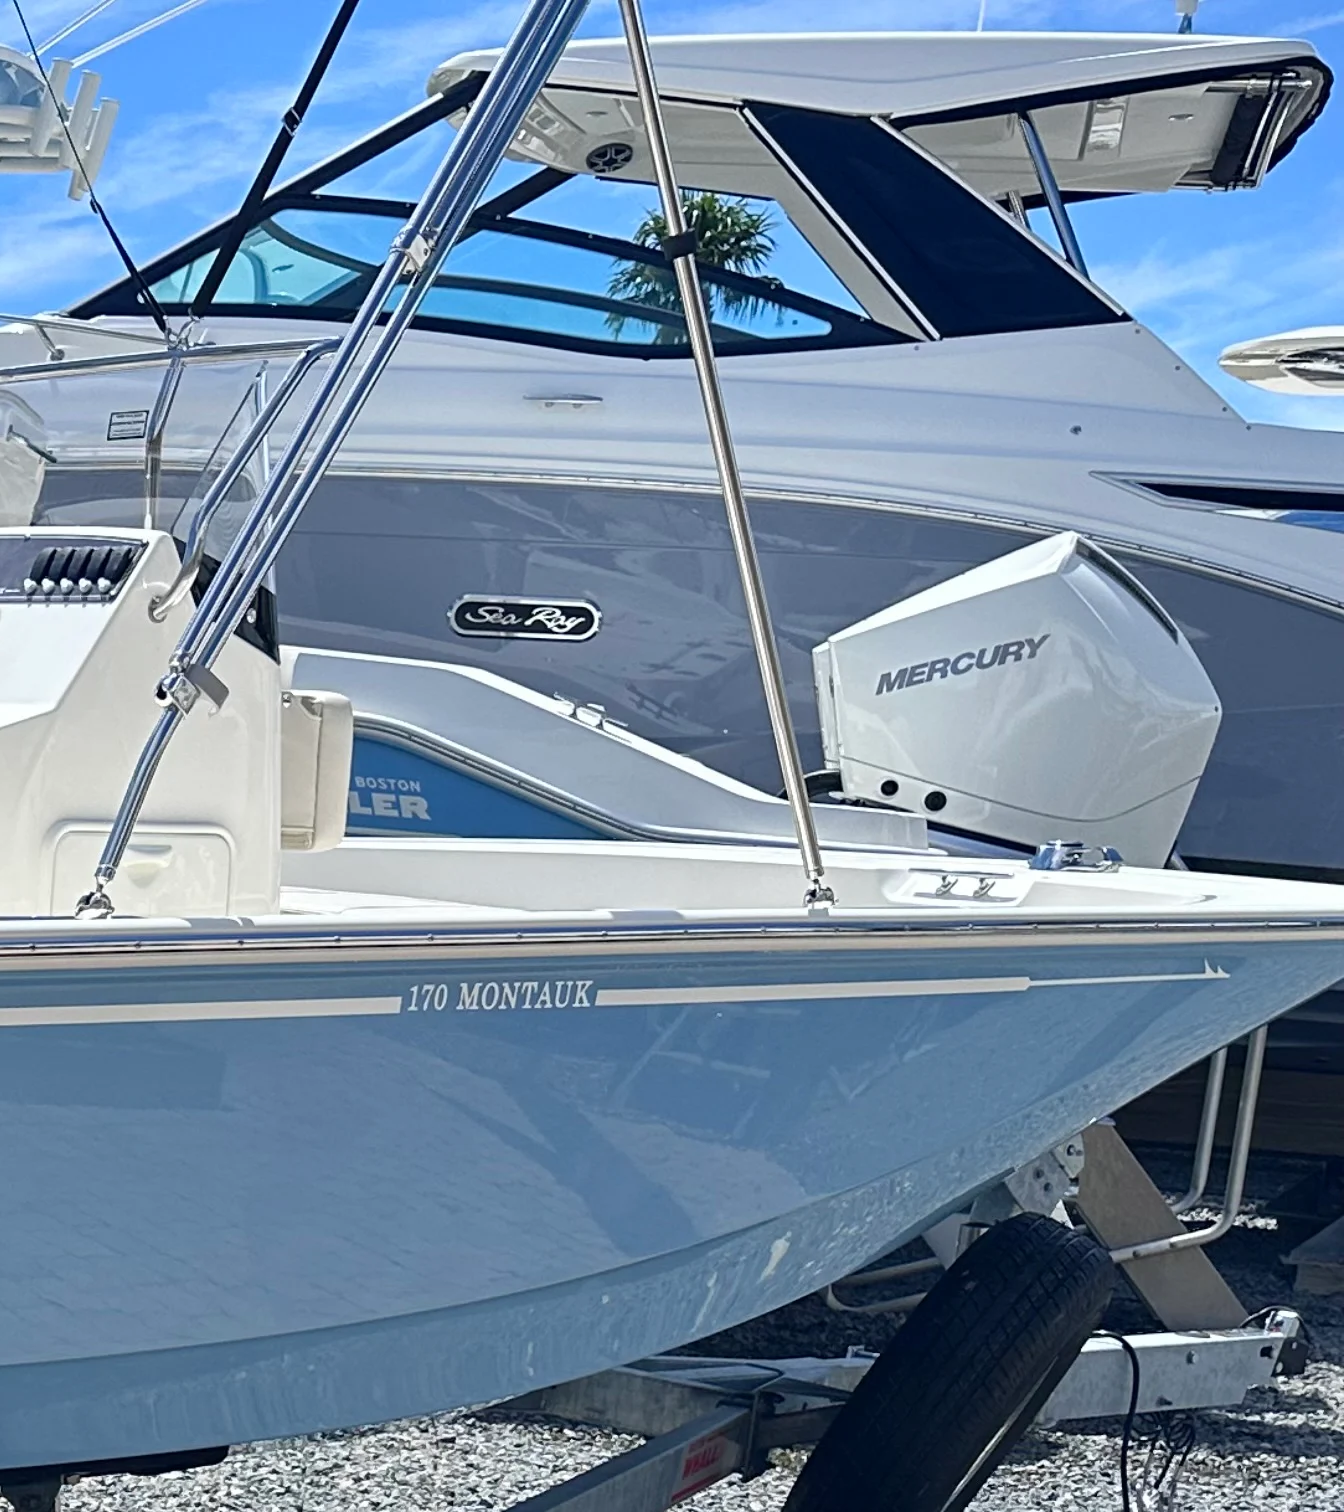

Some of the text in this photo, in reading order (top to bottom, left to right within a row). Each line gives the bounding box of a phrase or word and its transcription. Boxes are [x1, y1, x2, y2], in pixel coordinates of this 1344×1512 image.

[465, 606, 586, 633] Sea Ray
[875, 634, 1051, 695] MERCURY
[354, 776, 421, 792] BOSTON
[348, 791, 431, 820] LER
[407, 981, 593, 1011] 170 MONTAUK
